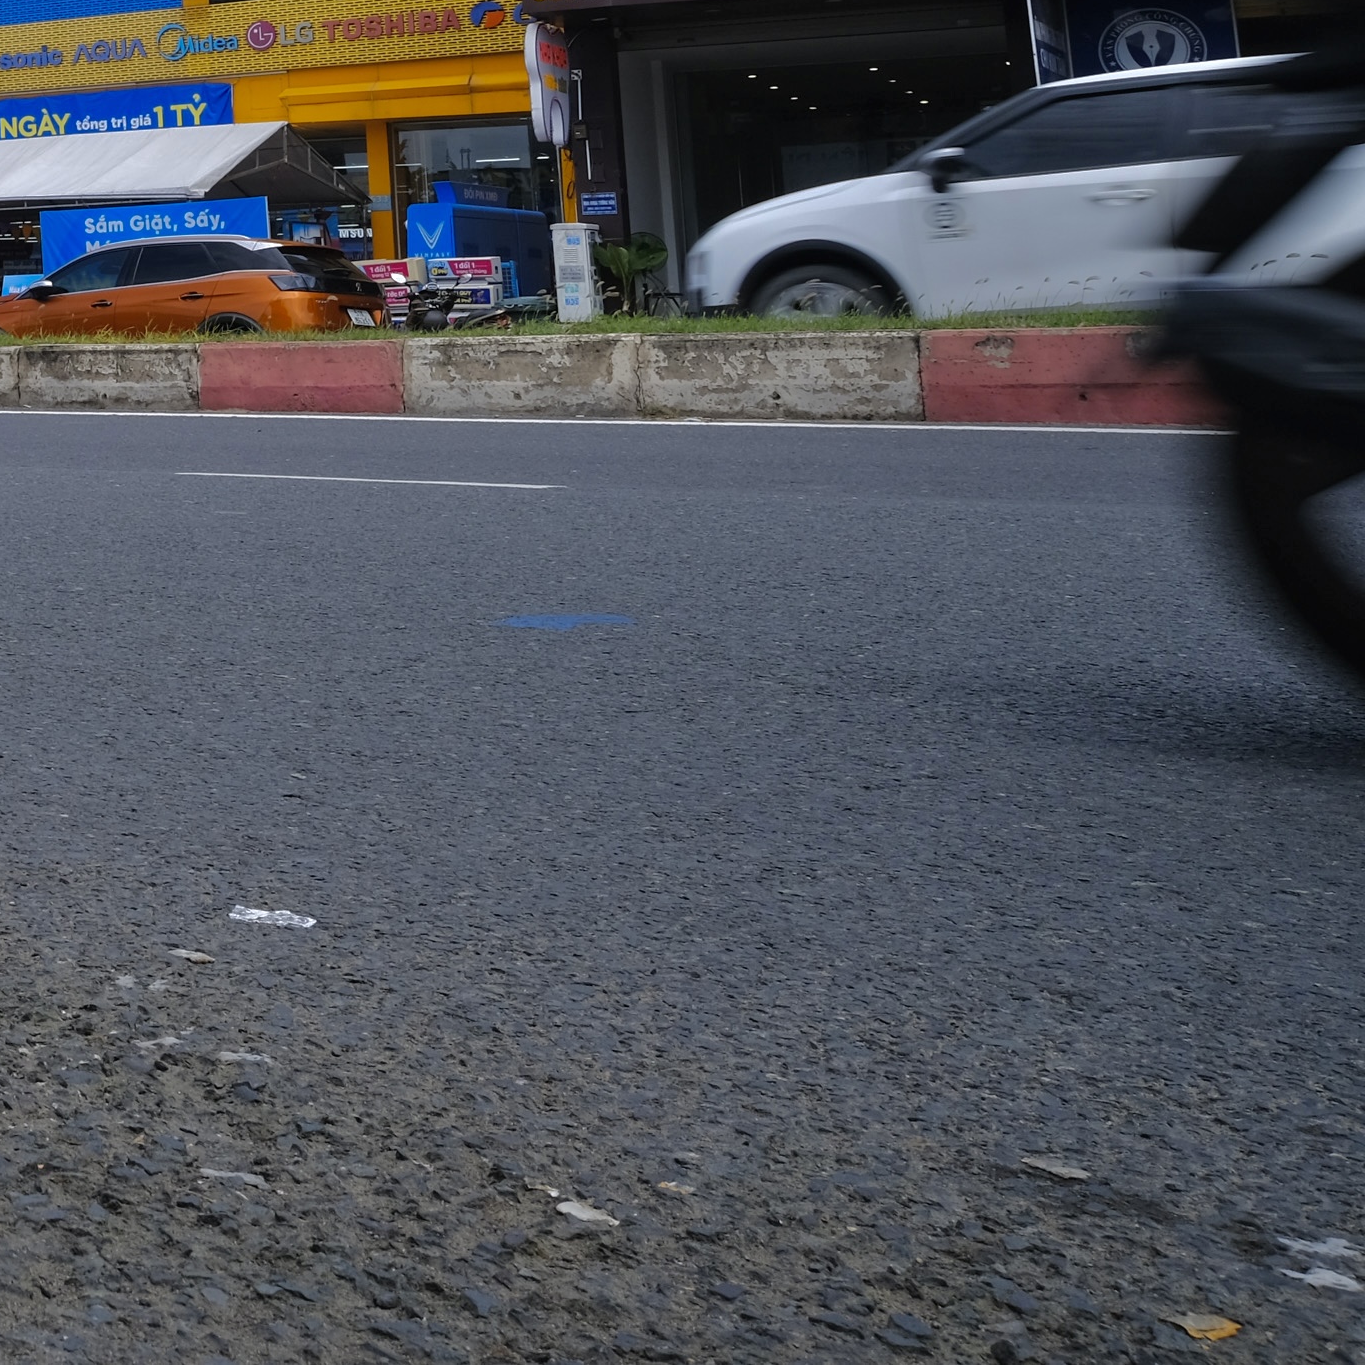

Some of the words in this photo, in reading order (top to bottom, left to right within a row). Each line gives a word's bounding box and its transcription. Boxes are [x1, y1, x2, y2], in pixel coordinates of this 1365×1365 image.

[72, 38, 148, 64] AQUA
[174, 29, 239, 55] Midea
[279, 21, 314, 46] LG
[321, 8, 461, 42] TOSHIBA
[0, 108, 71, 139] NGÀY
[76, 116, 107, 131] tổng
[111, 116, 127, 130] trị
[130, 114, 152, 129] giá
[153, 106, 164, 128] 1
[170, 93, 207, 127] TỶ
[84, 216, 124, 234] Sắm
[130, 214, 178, 235] Giặt,
[184, 209, 226, 230] Sấy,
